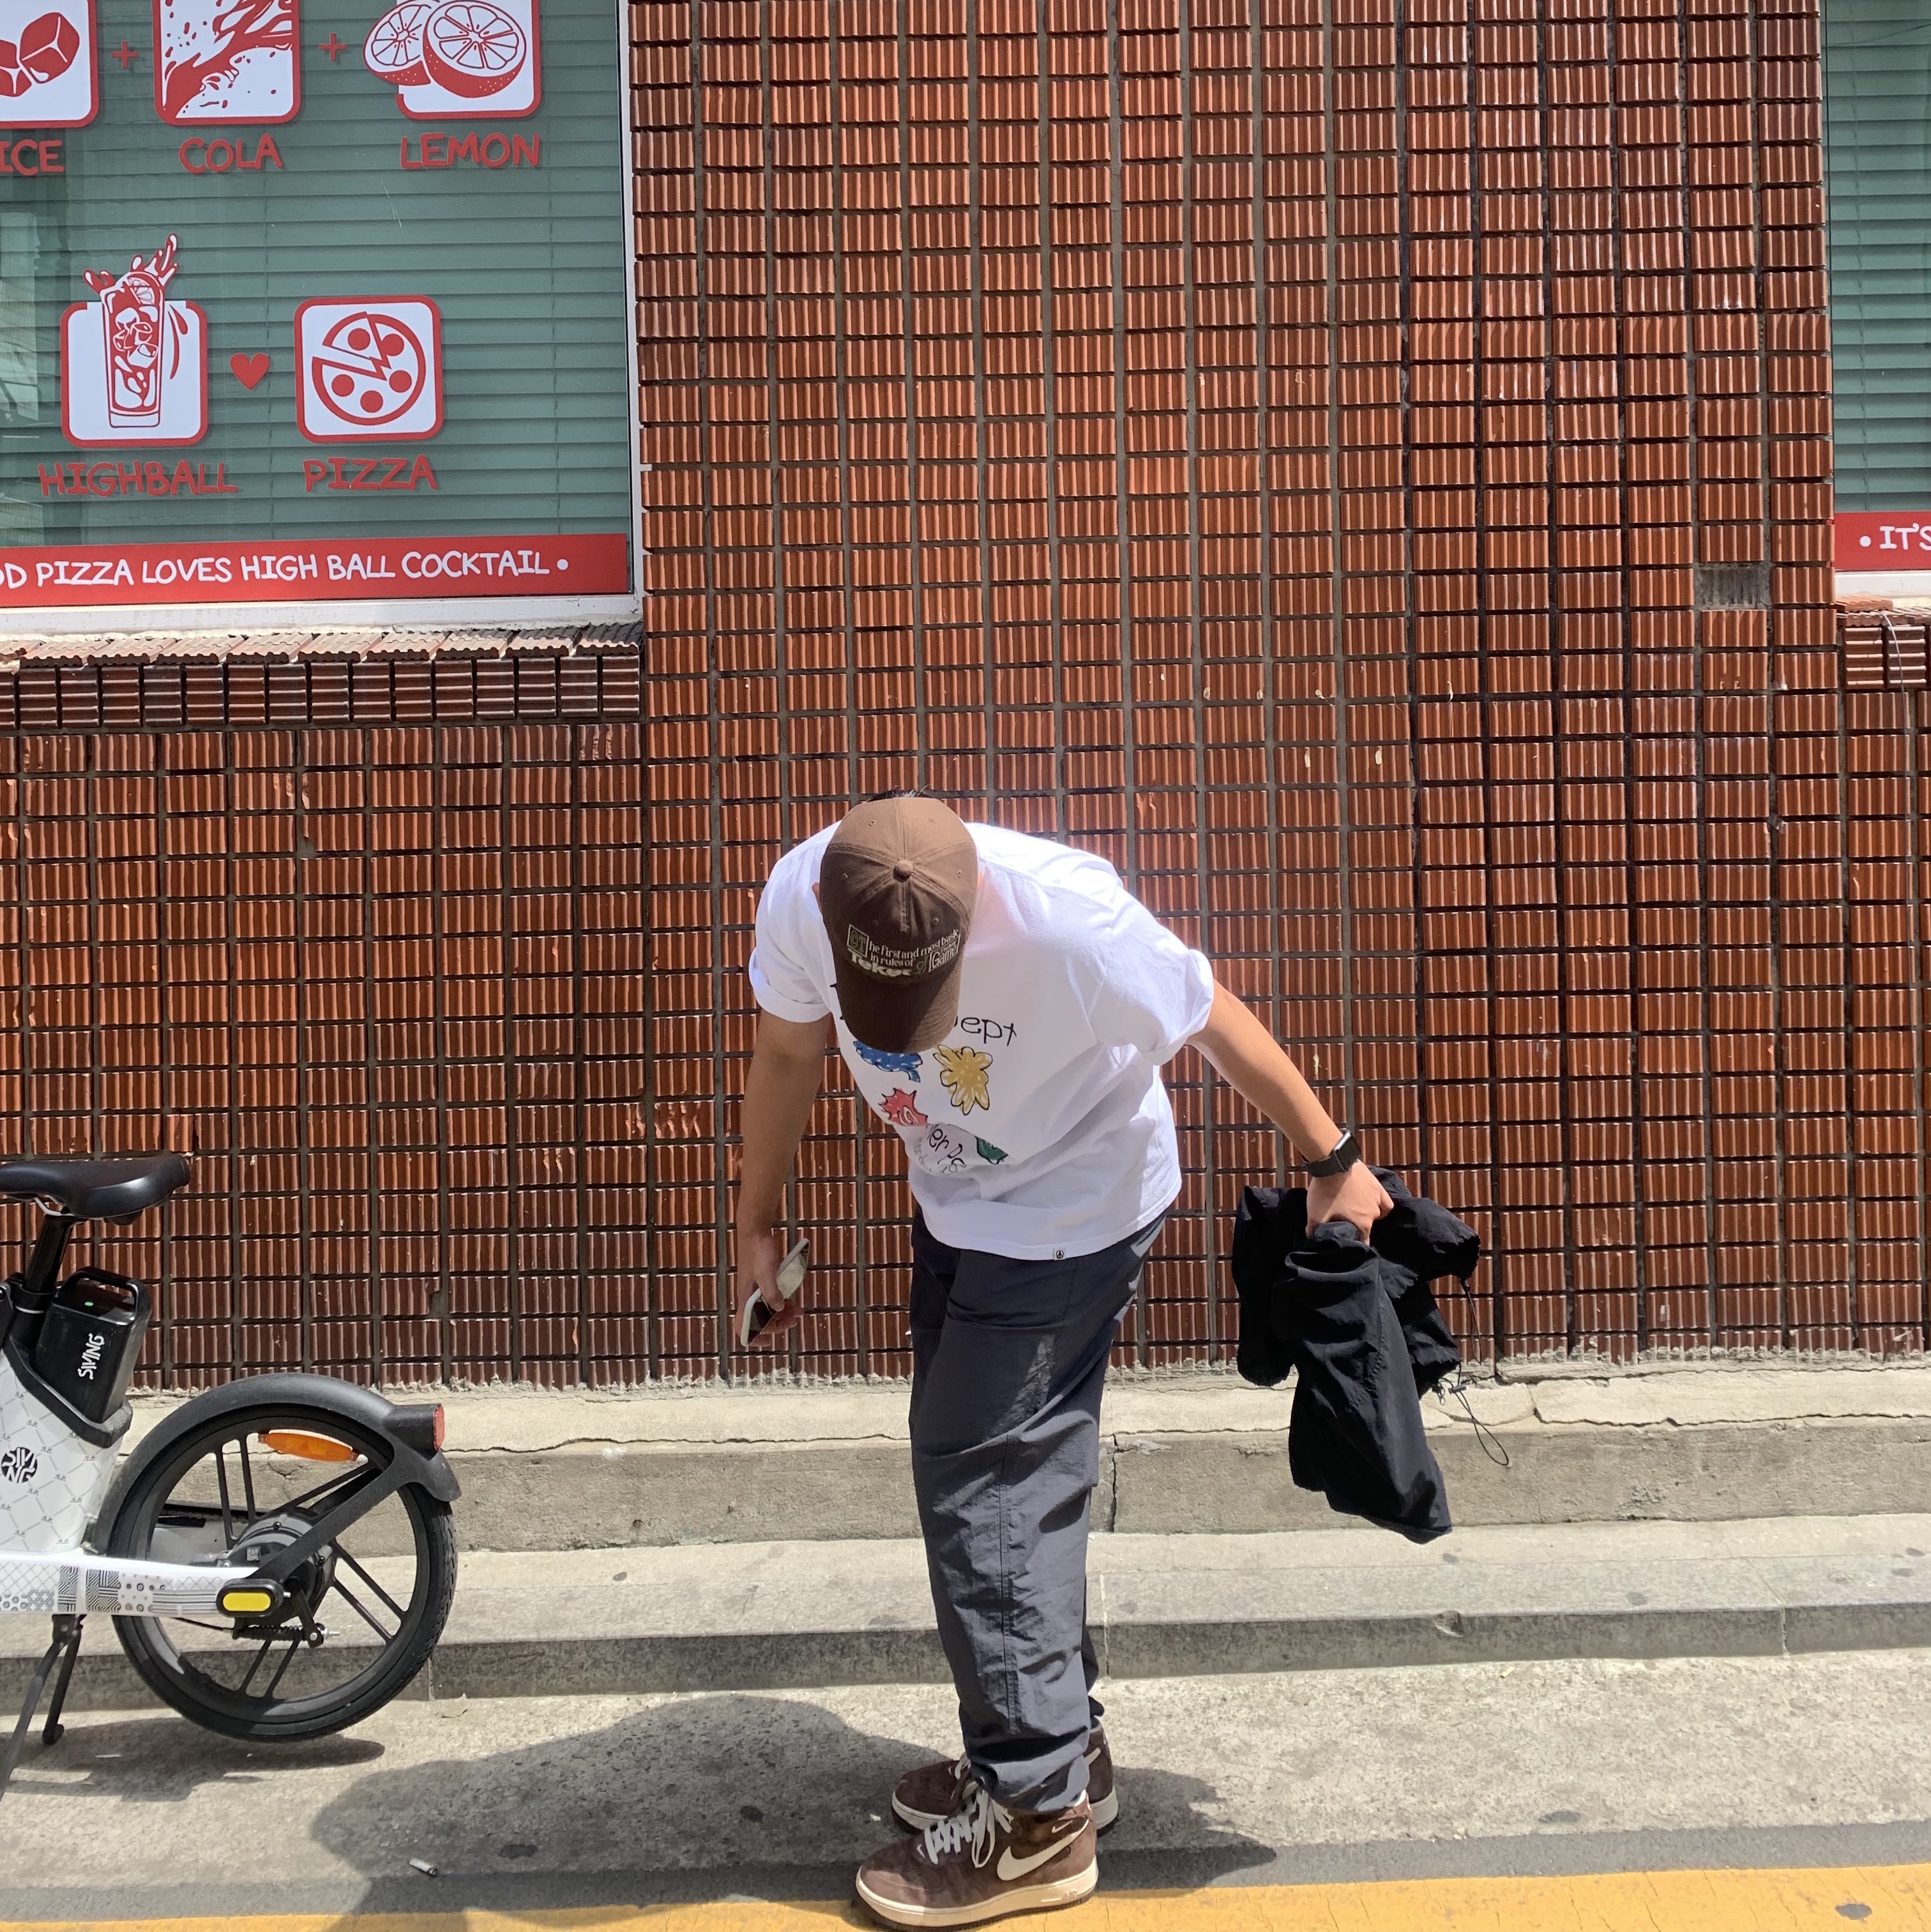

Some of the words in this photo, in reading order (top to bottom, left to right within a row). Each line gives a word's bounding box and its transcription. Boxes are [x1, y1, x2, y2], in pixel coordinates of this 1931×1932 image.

[0, 139, 64, 175] ICE
[179, 133, 283, 174] COLA
[401, 133, 540, 169] LEMON
[38, 460, 238, 497] HIGHBALL
[303, 454, 437, 492] PIZZA
[0, 563, 27, 589] D
[36, 559, 135, 588] PIZZA
[142, 557, 232, 584] LOVES
[240, 554, 318, 581] HIGH
[326, 553, 396, 581] BALL
[401, 550, 550, 579] COCKTAIL
[870, 952, 879, 963] in
[881, 957, 904, 967] rules
[904, 958, 916, 967] of
[881, 945, 900, 959] first
[902, 947, 919, 959] and
[921, 939, 940, 956] most
[932, 946, 957, 969] Game
[954, 1015, 1017, 1046] ept
[77, 1333, 105, 1380] SWING
